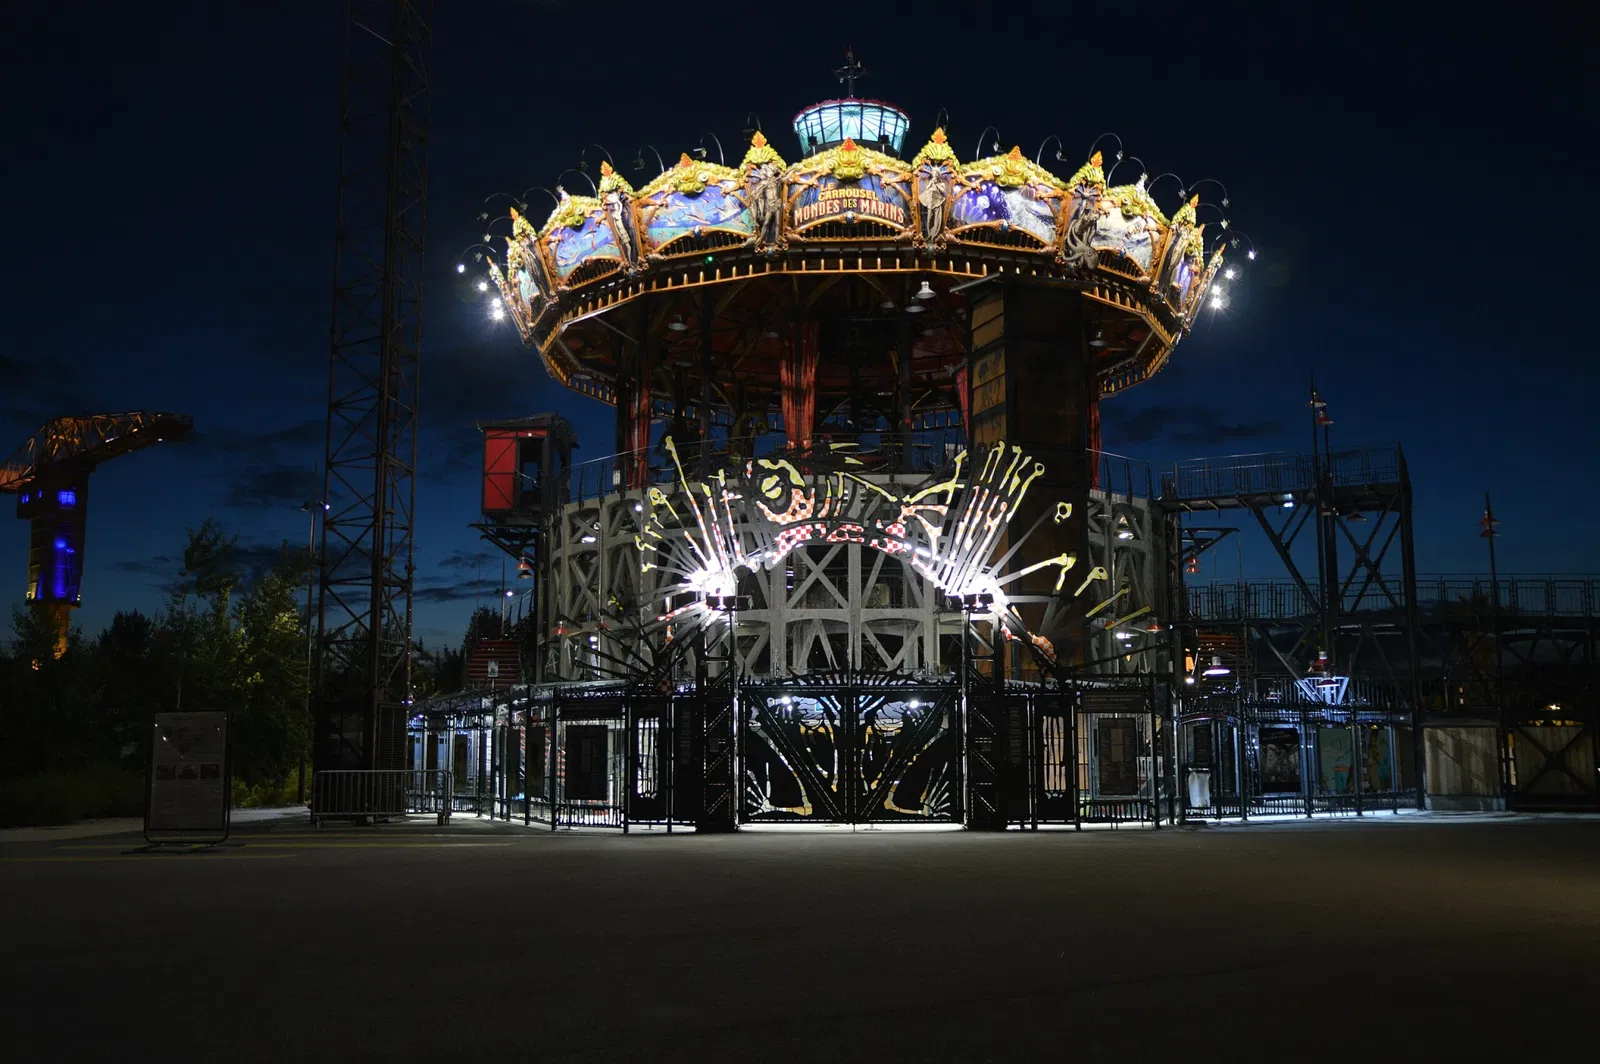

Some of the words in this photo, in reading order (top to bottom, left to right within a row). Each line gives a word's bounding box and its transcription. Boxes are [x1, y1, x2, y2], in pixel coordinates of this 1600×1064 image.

[820, 183, 835, 191] LE
[818, 188, 878, 201] CARROUSEL
[794, 200, 840, 225] MONDES
[843, 199, 857, 208] DES
[859, 199, 904, 223] MARINS
